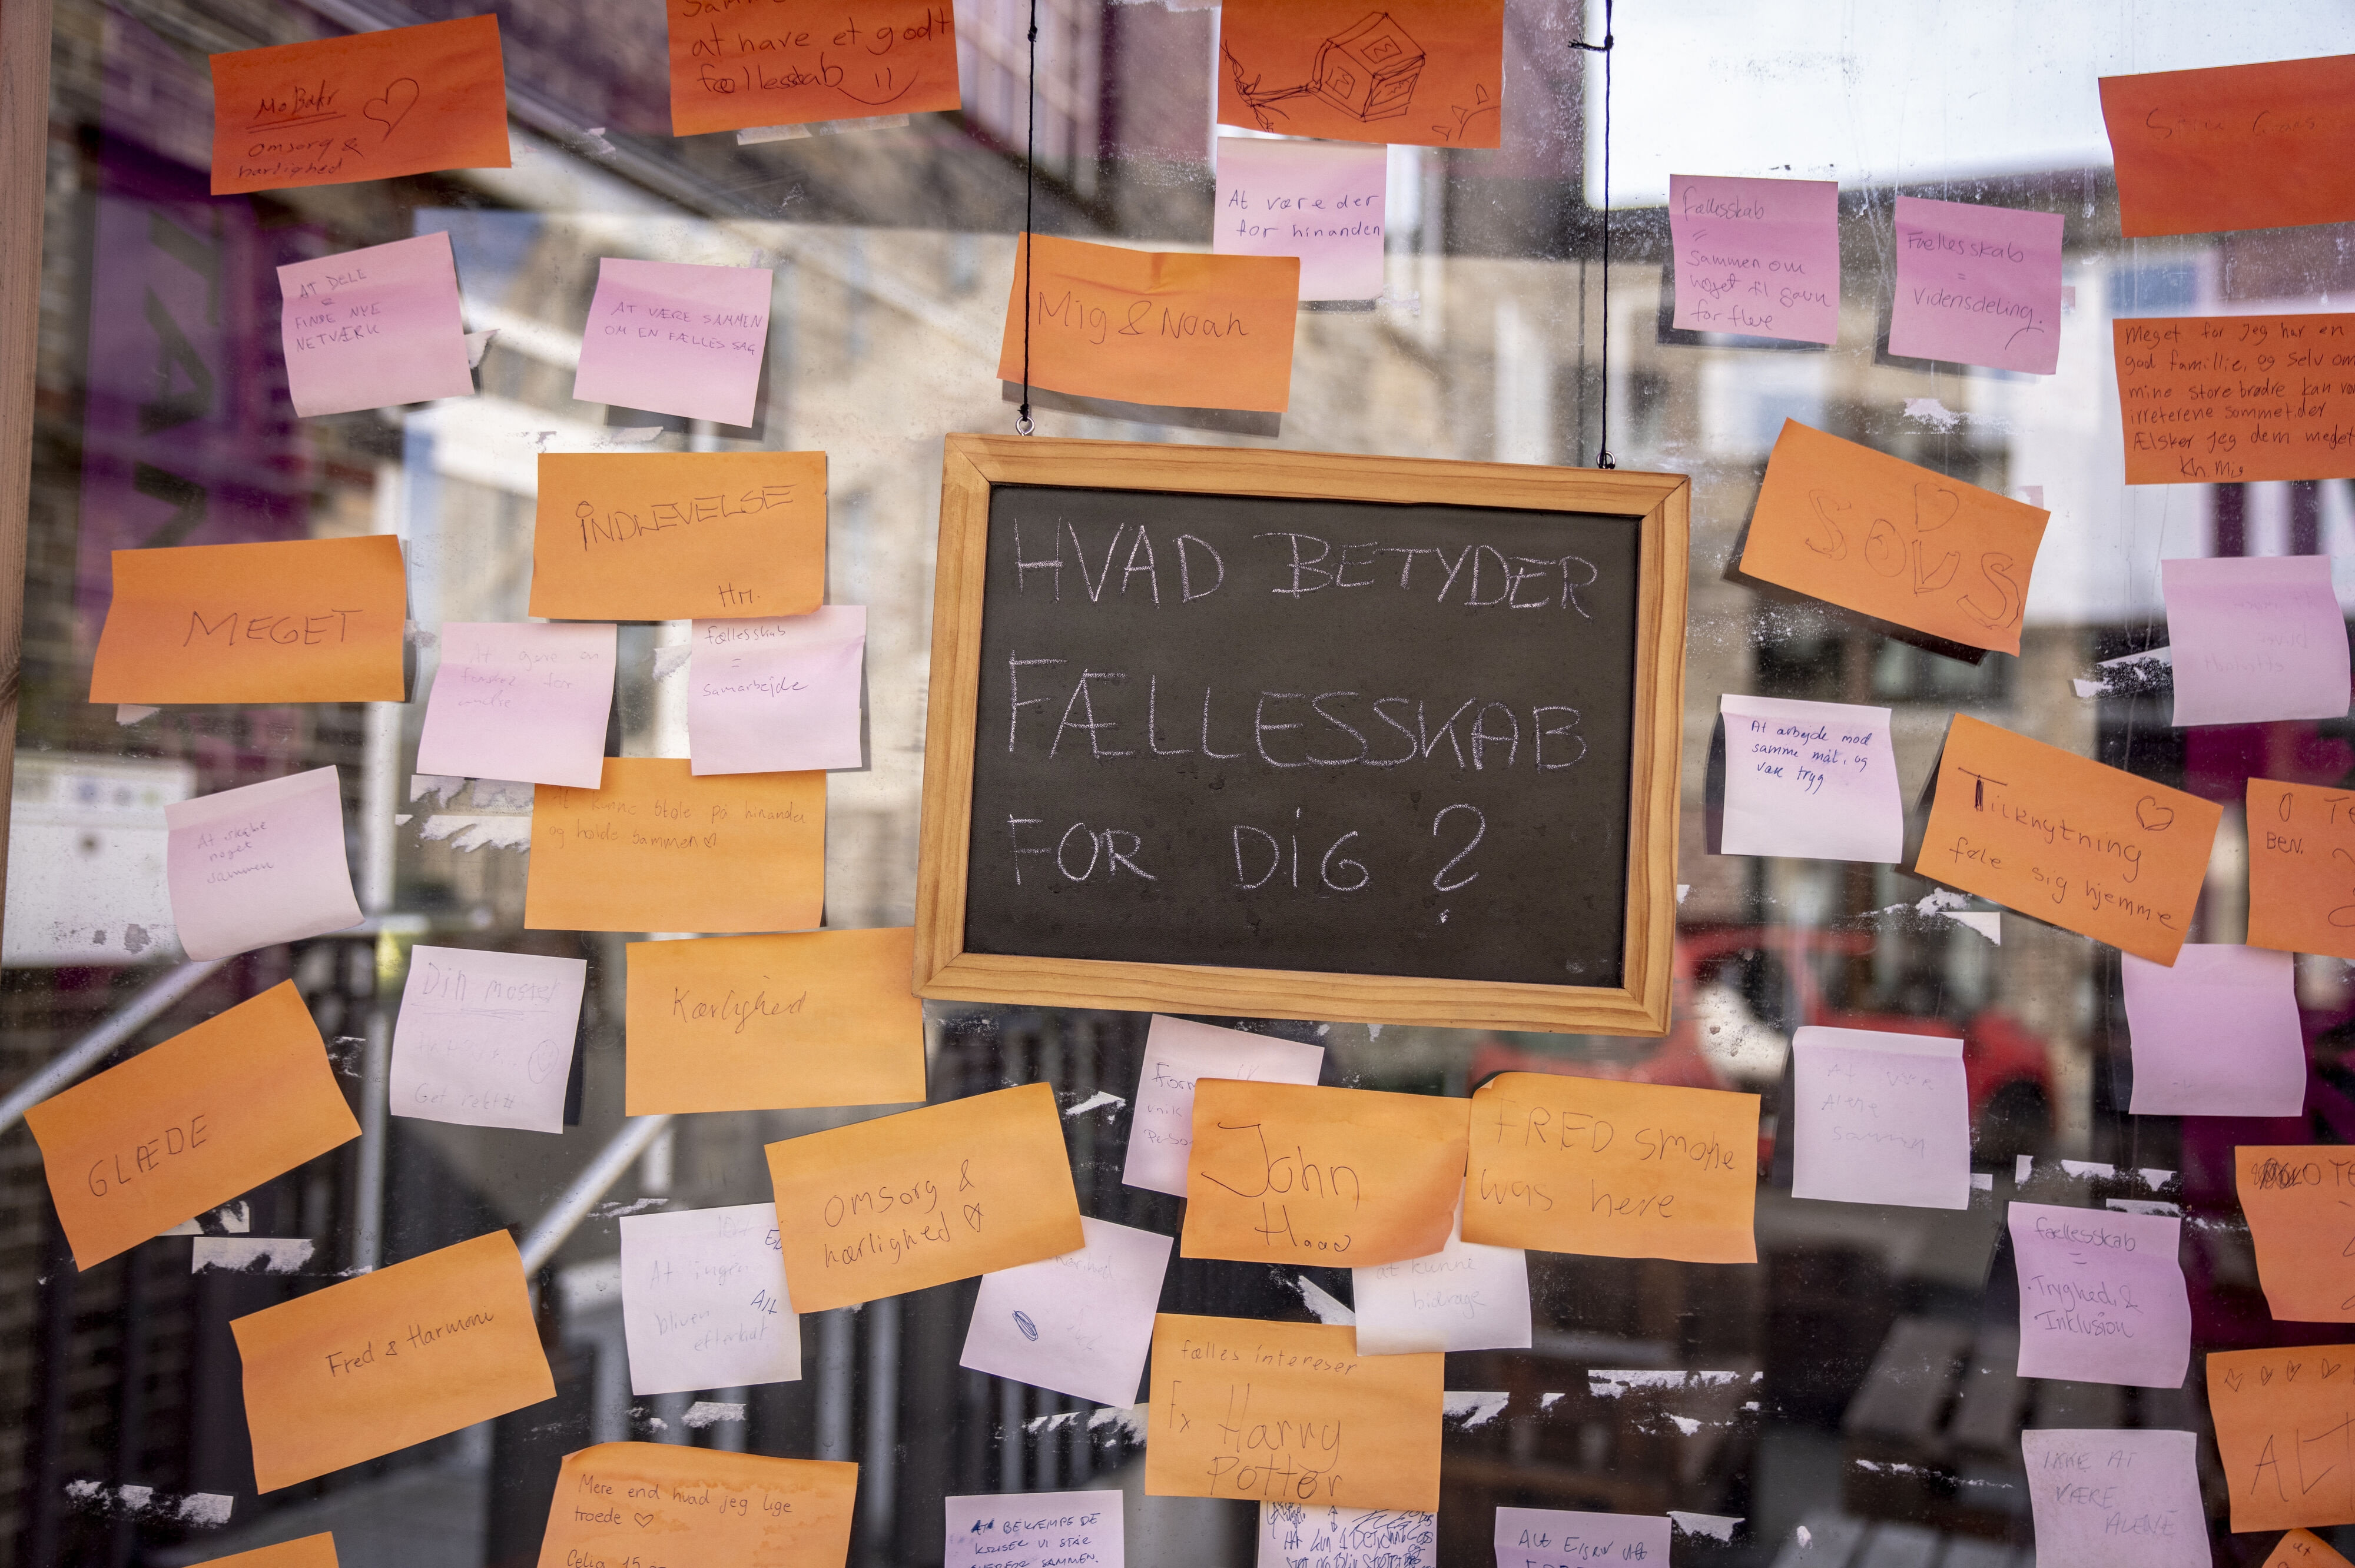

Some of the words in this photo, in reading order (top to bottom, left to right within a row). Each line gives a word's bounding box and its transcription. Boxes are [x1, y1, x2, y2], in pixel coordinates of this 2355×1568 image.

[739, 31, 810, 53] have
[833, 17, 862, 47] et
[1228, 190, 1248, 209] At
[1266, 195, 1325, 211] være
[1337, 192, 1379, 210] der
[1237, 219, 1279, 238] for
[1292, 221, 1381, 237] hinanden
[1769, 261, 1805, 274] om
[1690, 298, 1723, 322] for
[1780, 287, 1831, 308] gavn
[611, 301, 637, 315] AT
[649, 308, 691, 323] VÆRE
[704, 313, 764, 328] SAMMEN
[1038, 290, 1107, 344] Mig
[1117, 300, 1153, 335] &
[1161, 307, 1249, 339] Noah
[2201, 324, 2224, 339] for
[2281, 322, 2305, 339] har
[2319, 324, 2344, 337] en
[605, 325, 626, 335] OM
[639, 327, 658, 338] EN
[669, 332, 725, 348] FÆLLES
[732, 341, 755, 355] SAG
[2125, 353, 2156, 376] god
[2257, 355, 2276, 372] og
[2128, 386, 2173, 399] mine
[2302, 377, 2331, 397] kan
[2250, 423, 2290, 444] dem
[1012, 517, 1225, 609] HVAD
[1252, 532, 1597, 622] BETYDER
[183, 609, 363, 647] MEGET
[1008, 649, 1588, 773] FÆLLESSKAB
[1751, 720, 1766, 733] At
[1777, 726, 1829, 746] arbejde
[1842, 733, 1873, 746] mod
[1752, 743, 1799, 758] samme
[1855, 756, 1868, 772] og
[1797, 766, 1823, 795] tryg
[1958, 766, 2142, 883] Tilknytning
[1007, 813, 1157, 886] FOR
[1432, 802, 1486, 924] ?
[2087, 880, 2178, 931] hjemme
[88, 1114, 208, 1198] GLÆDE
[1201, 1121, 1359, 1212] John
[824, 1179, 938, 1228] Omsorg
[1591, 1178, 1675, 1218] here
[326, 1341, 375, 1377] Fred
[386, 1341, 397, 1356] &
[406, 1305, 494, 1348] Harmoni
[1169, 1380, 1191, 1434] Fx
[1218, 1383, 1342, 1474] Harry
[1207, 1453, 1343, 1500] Potter
[578, 1473, 614, 1495] Mere
[628, 1484, 659, 1499] end
[673, 1490, 709, 1506] hvad
[719, 1495, 748, 1516] jeg
[763, 1494, 794, 1517] lige
[1080, 1513, 1101, 1526] DE
[1038, 1539, 1048, 1548] VI
